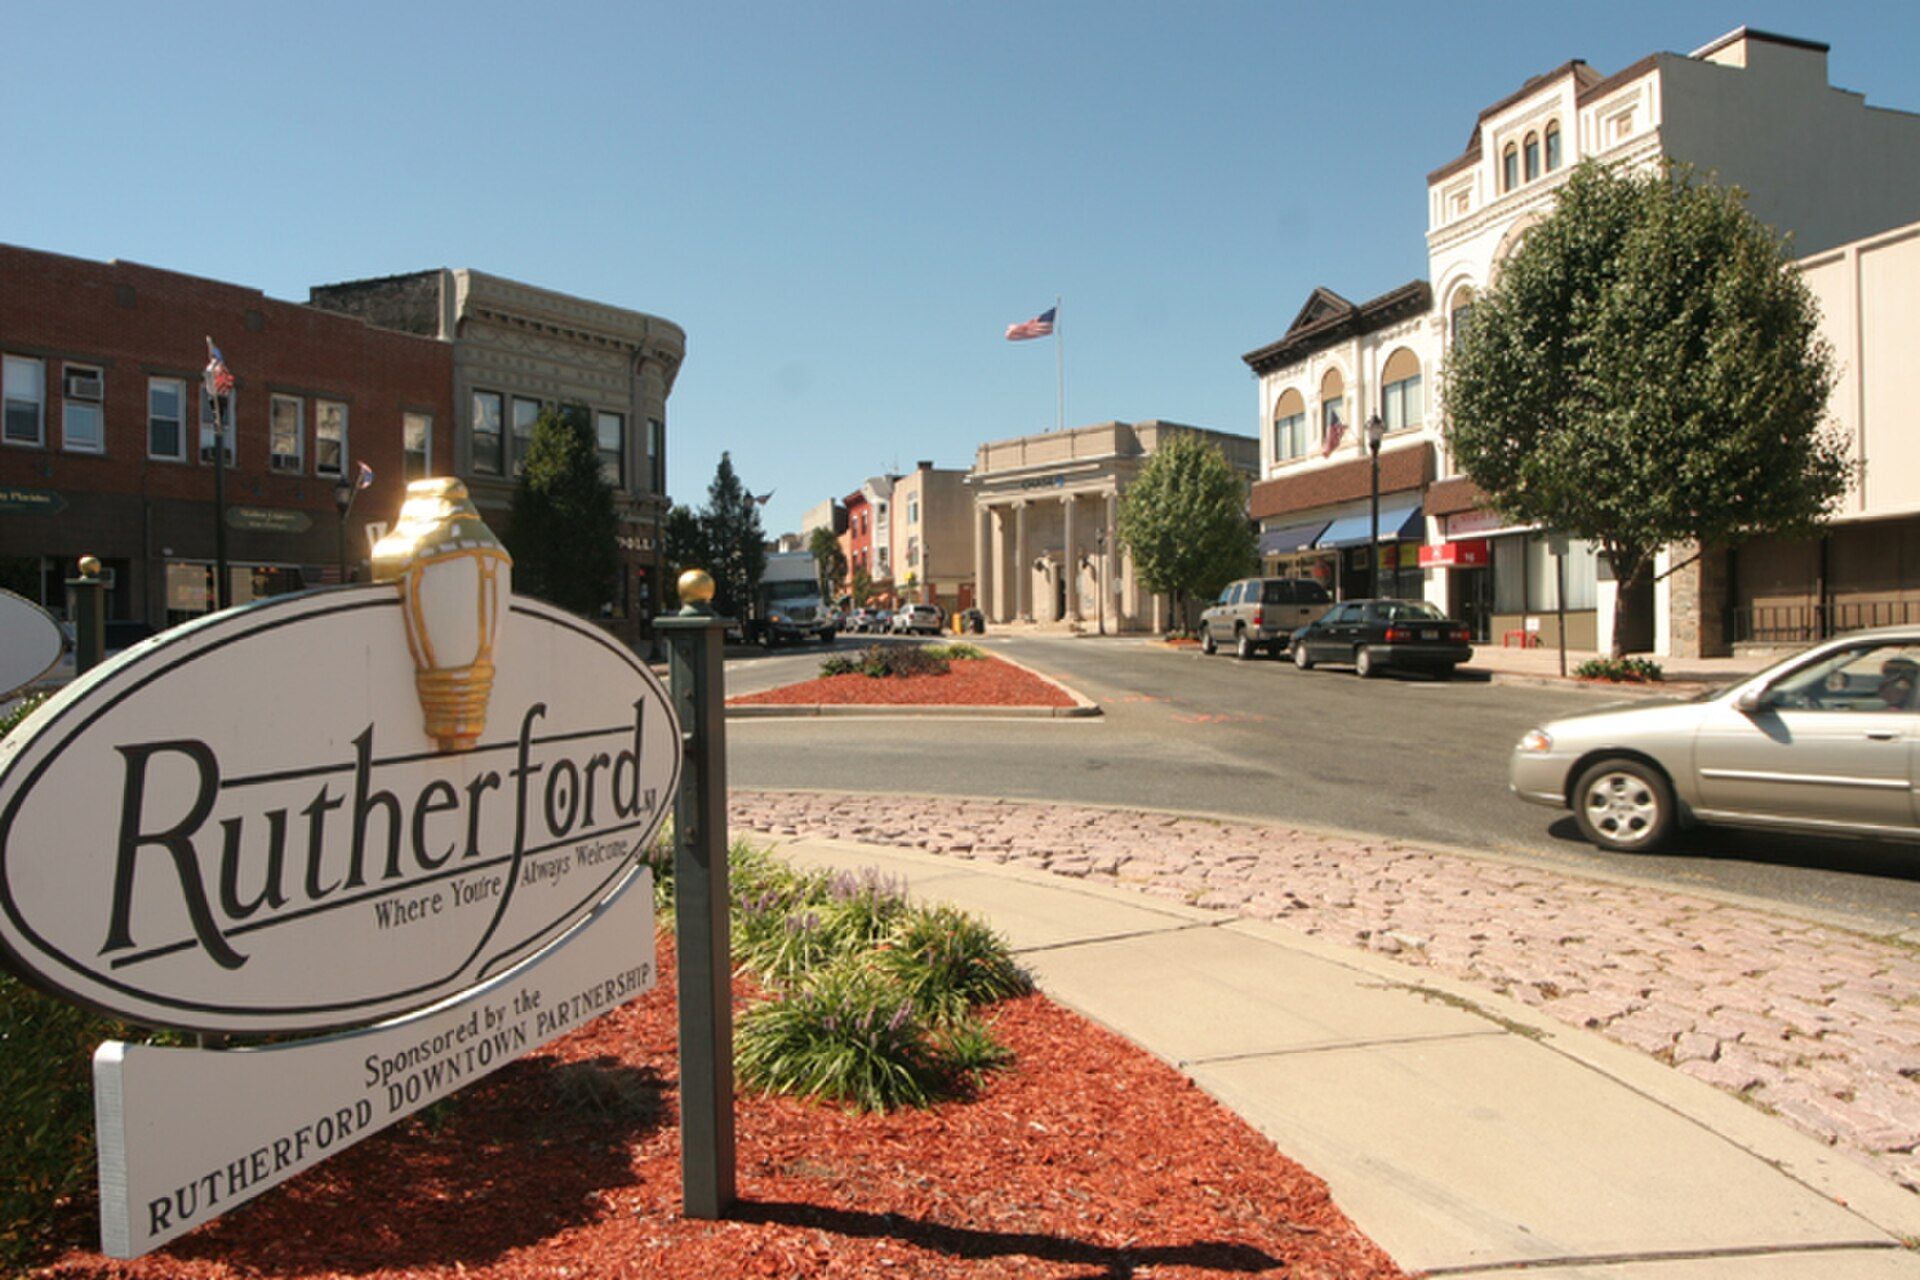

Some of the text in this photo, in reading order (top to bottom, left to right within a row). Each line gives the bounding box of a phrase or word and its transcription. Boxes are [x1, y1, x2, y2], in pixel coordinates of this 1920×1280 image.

[96, 696, 646, 970] Rutherford
[374, 896, 443, 931] Where
[520, 853, 572, 888] Always
[575, 838, 628, 867] Welcome
[146, 962, 651, 1238] RUTHERFORD DOWNTOWN PARTNERSHIP
[365, 989, 541, 1089] Sponsored by the
